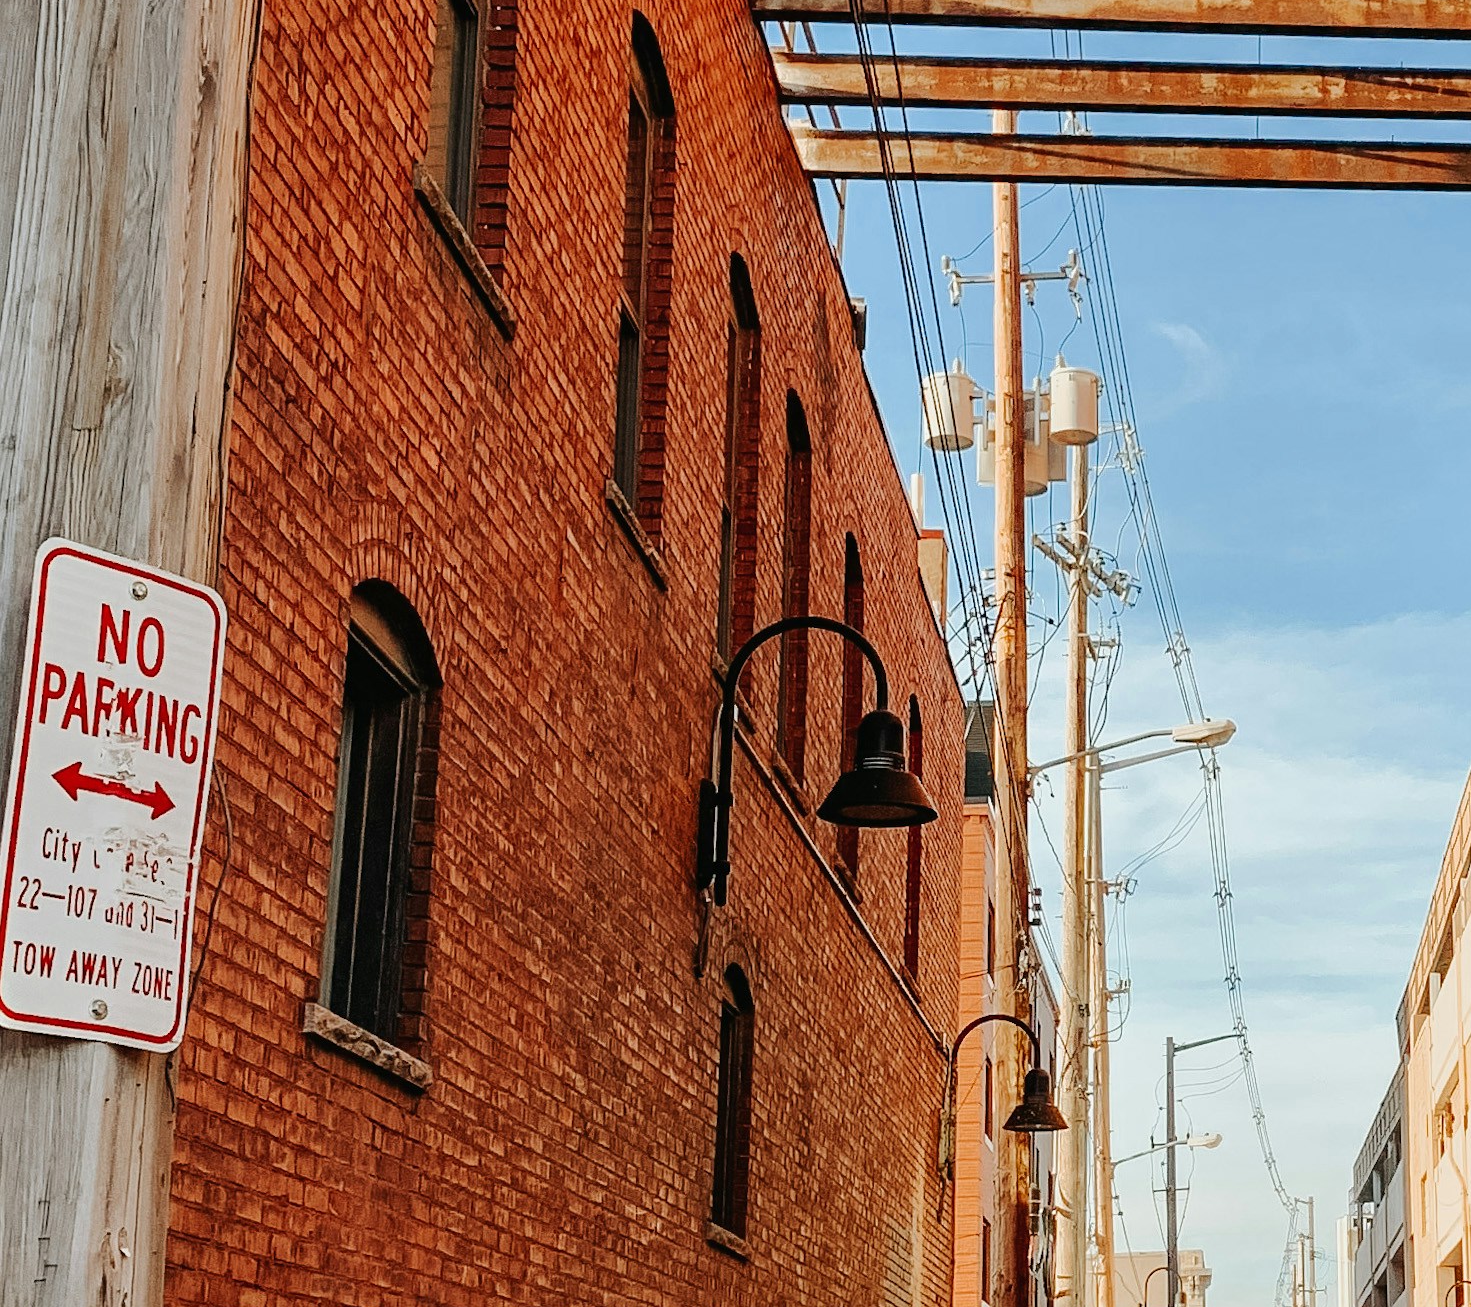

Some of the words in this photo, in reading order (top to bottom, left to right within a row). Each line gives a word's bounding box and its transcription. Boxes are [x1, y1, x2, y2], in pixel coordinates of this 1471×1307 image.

[98, 603, 166, 678] NO
[38, 662, 202, 765] PARKING
[42, 827, 82, 874] City
[12, 940, 56, 979] TOW
[65, 949, 123, 990] AWAY
[131, 961, 174, 1002] ZONE
